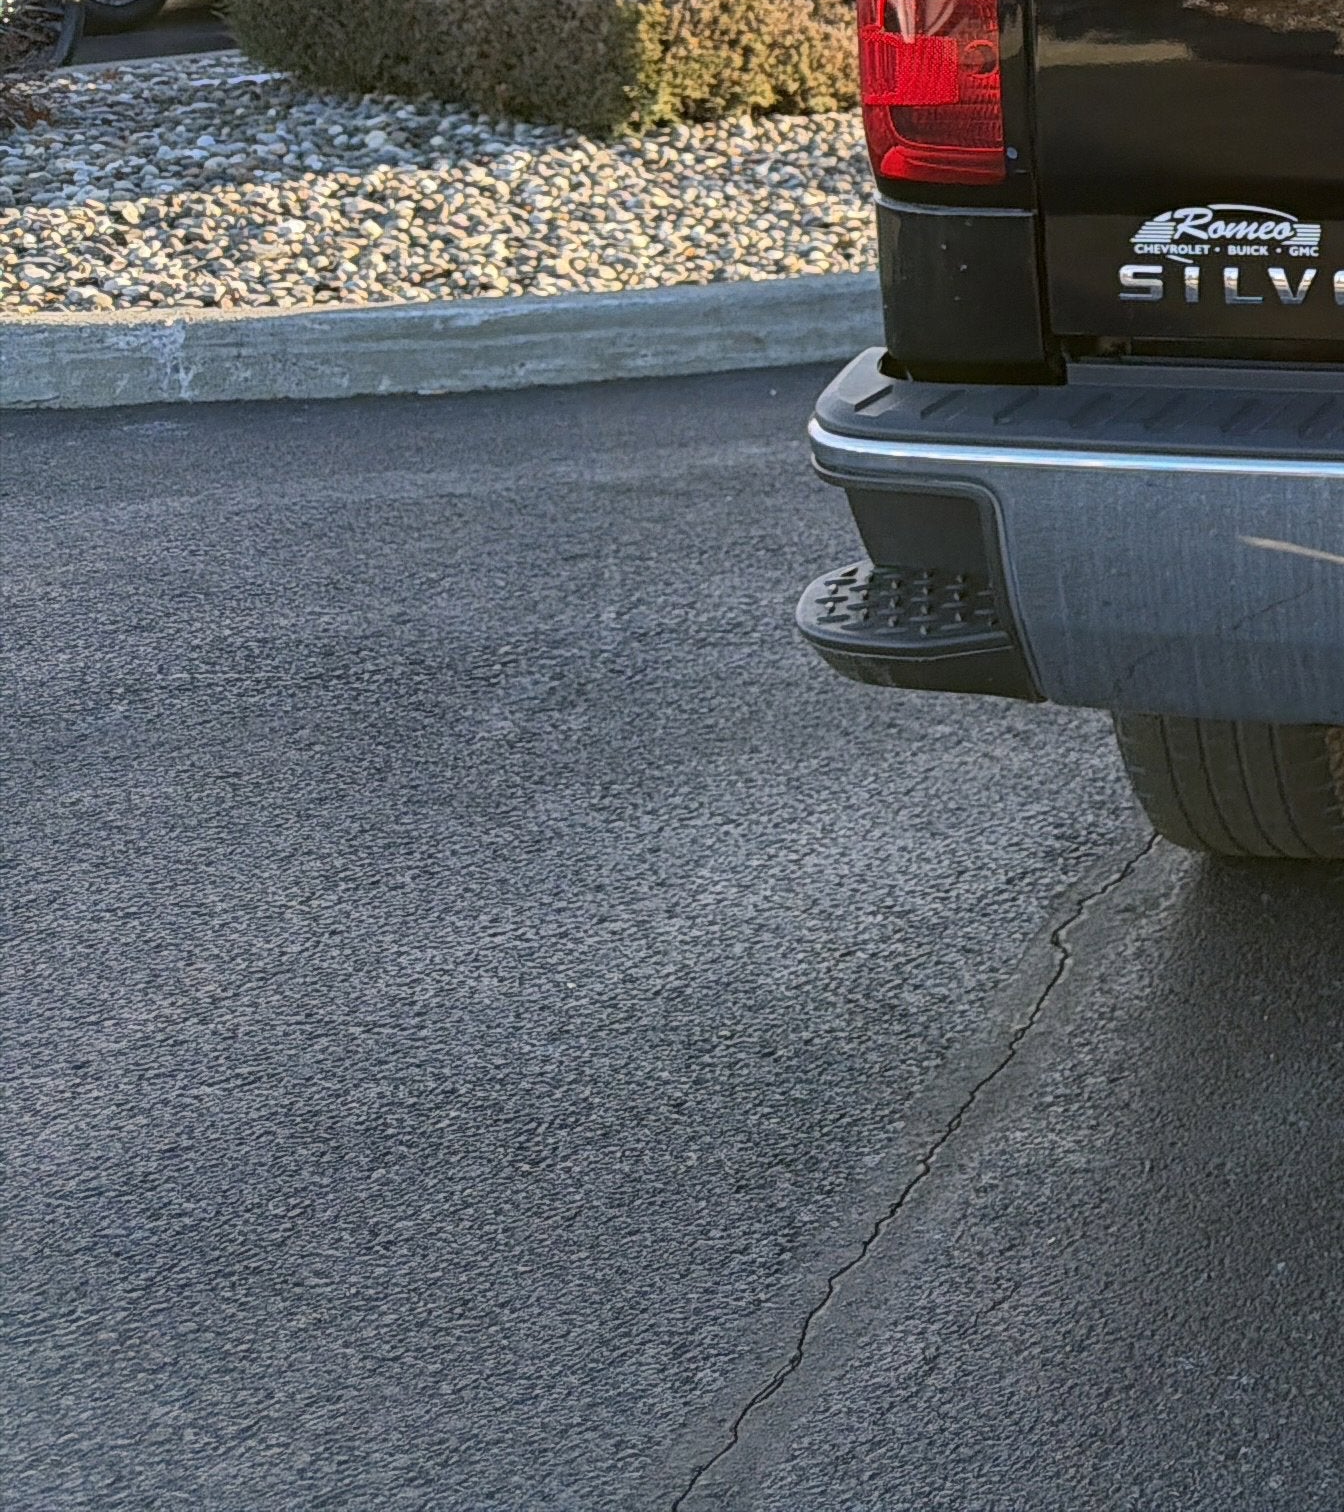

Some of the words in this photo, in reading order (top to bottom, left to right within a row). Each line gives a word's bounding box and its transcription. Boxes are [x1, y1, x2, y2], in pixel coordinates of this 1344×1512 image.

[1173, 207, 1294, 240] Romeo
[1133, 243, 1211, 255] CHEVROLET
[1227, 245, 1269, 256] BUICK
[1288, 245, 1320, 257] GMC
